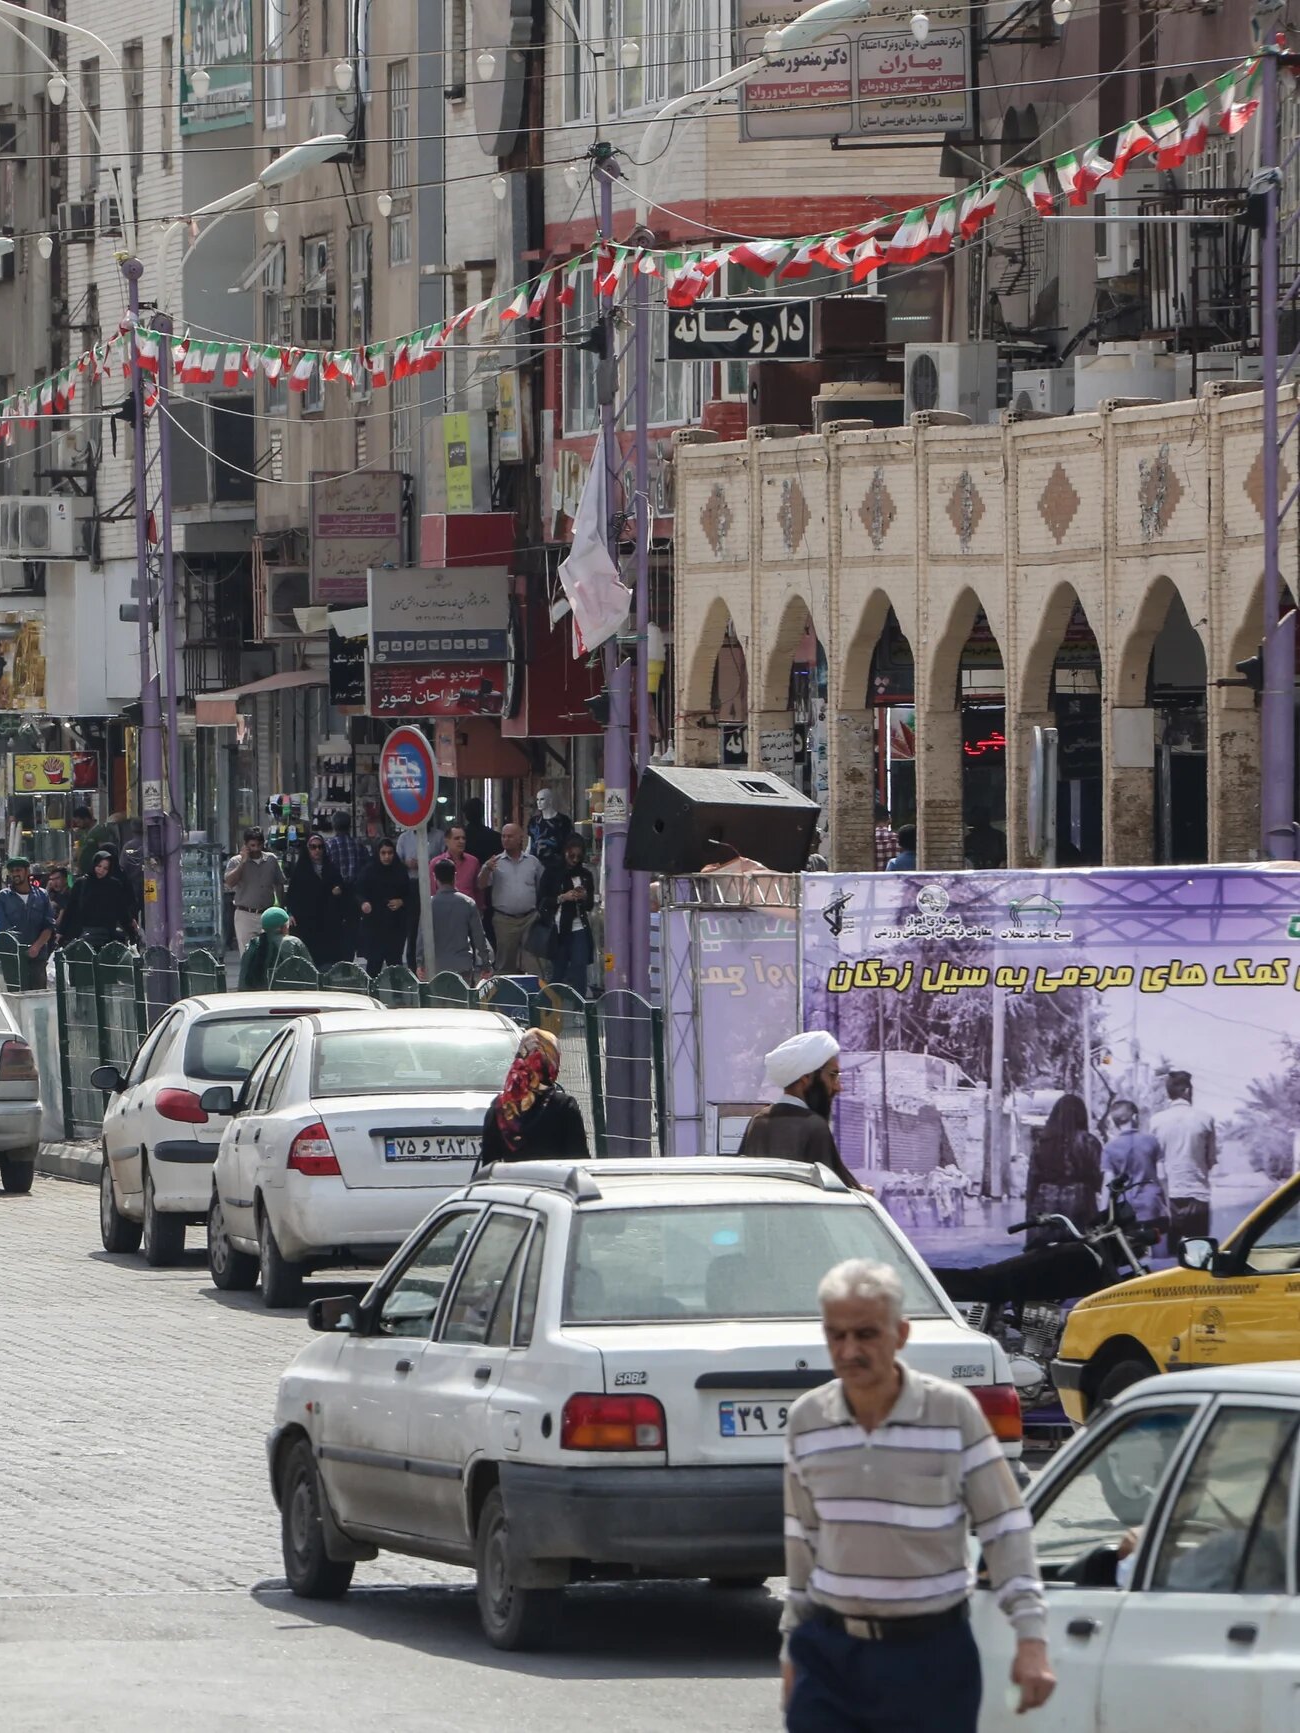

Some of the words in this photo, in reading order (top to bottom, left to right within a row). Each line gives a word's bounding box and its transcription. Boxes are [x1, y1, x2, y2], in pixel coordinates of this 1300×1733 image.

[898, 39, 920, 52] درمان
[785, 52, 823, 73] منصور
[821, 48, 848, 71] دکتر
[879, 53, 943, 74] بهاران
[779, 83, 811, 99] اعصاب
[811, 83, 849, 98] متخصص
[862, 117, 881, 129] استان
[905, 115, 927, 127] سازمان
[928, 113, 950, 125] نظارت
[674, 306, 805, 354] داروخانه
[414, 668, 447, 685] عکاسی
[449, 668, 483, 684] استودیو
[377, 690, 413, 709] تصویر
[413, 688, 461, 707] طراحان
[905, 914, 928, 927] اهواز
[927, 914, 962, 927] شهرداری
[874, 928, 902, 941] ورزشی
[902, 928, 936, 940] اجتماعی
[936, 927, 965, 940] فرهنگی
[964, 928, 993, 939] معاونت
[1000, 930, 1026, 941] محلات
[1024, 931, 1053, 941] مساجد
[827, 958, 914, 995] زدگان
[920, 960, 990, 995] سیل
[995, 964, 1030, 994] به
[1033, 965, 1135, 994] مردمی
[1139, 958, 1208, 993] های
[1213, 957, 1291, 986] کمک
